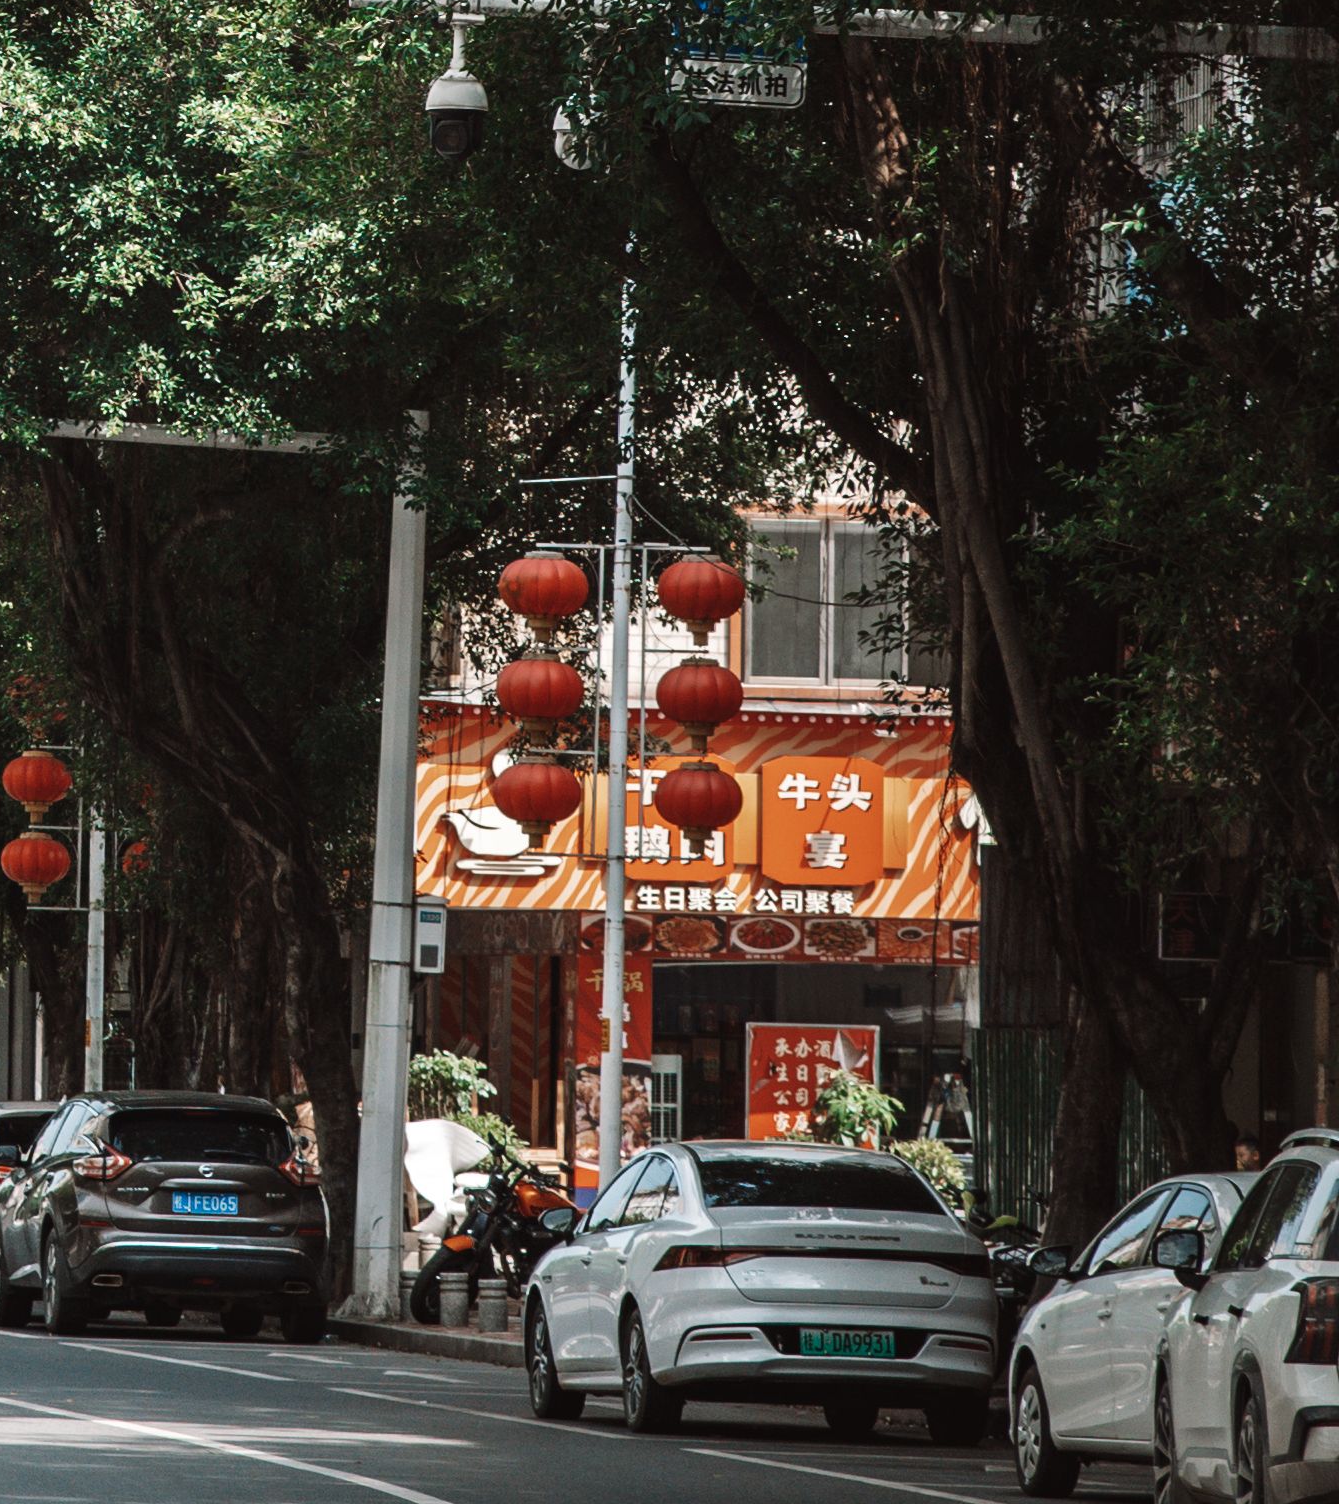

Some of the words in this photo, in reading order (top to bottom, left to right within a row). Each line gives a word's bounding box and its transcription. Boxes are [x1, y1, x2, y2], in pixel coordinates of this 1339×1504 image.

[777, 773, 872, 812] 牛头
[803, 830, 848, 869] 宴
[636, 886, 739, 913] 生日聚会
[753, 888, 855, 915] 公司聚餐
[775, 1037, 832, 1059] 承办酒
[773, 1087, 823, 1107] 公司
